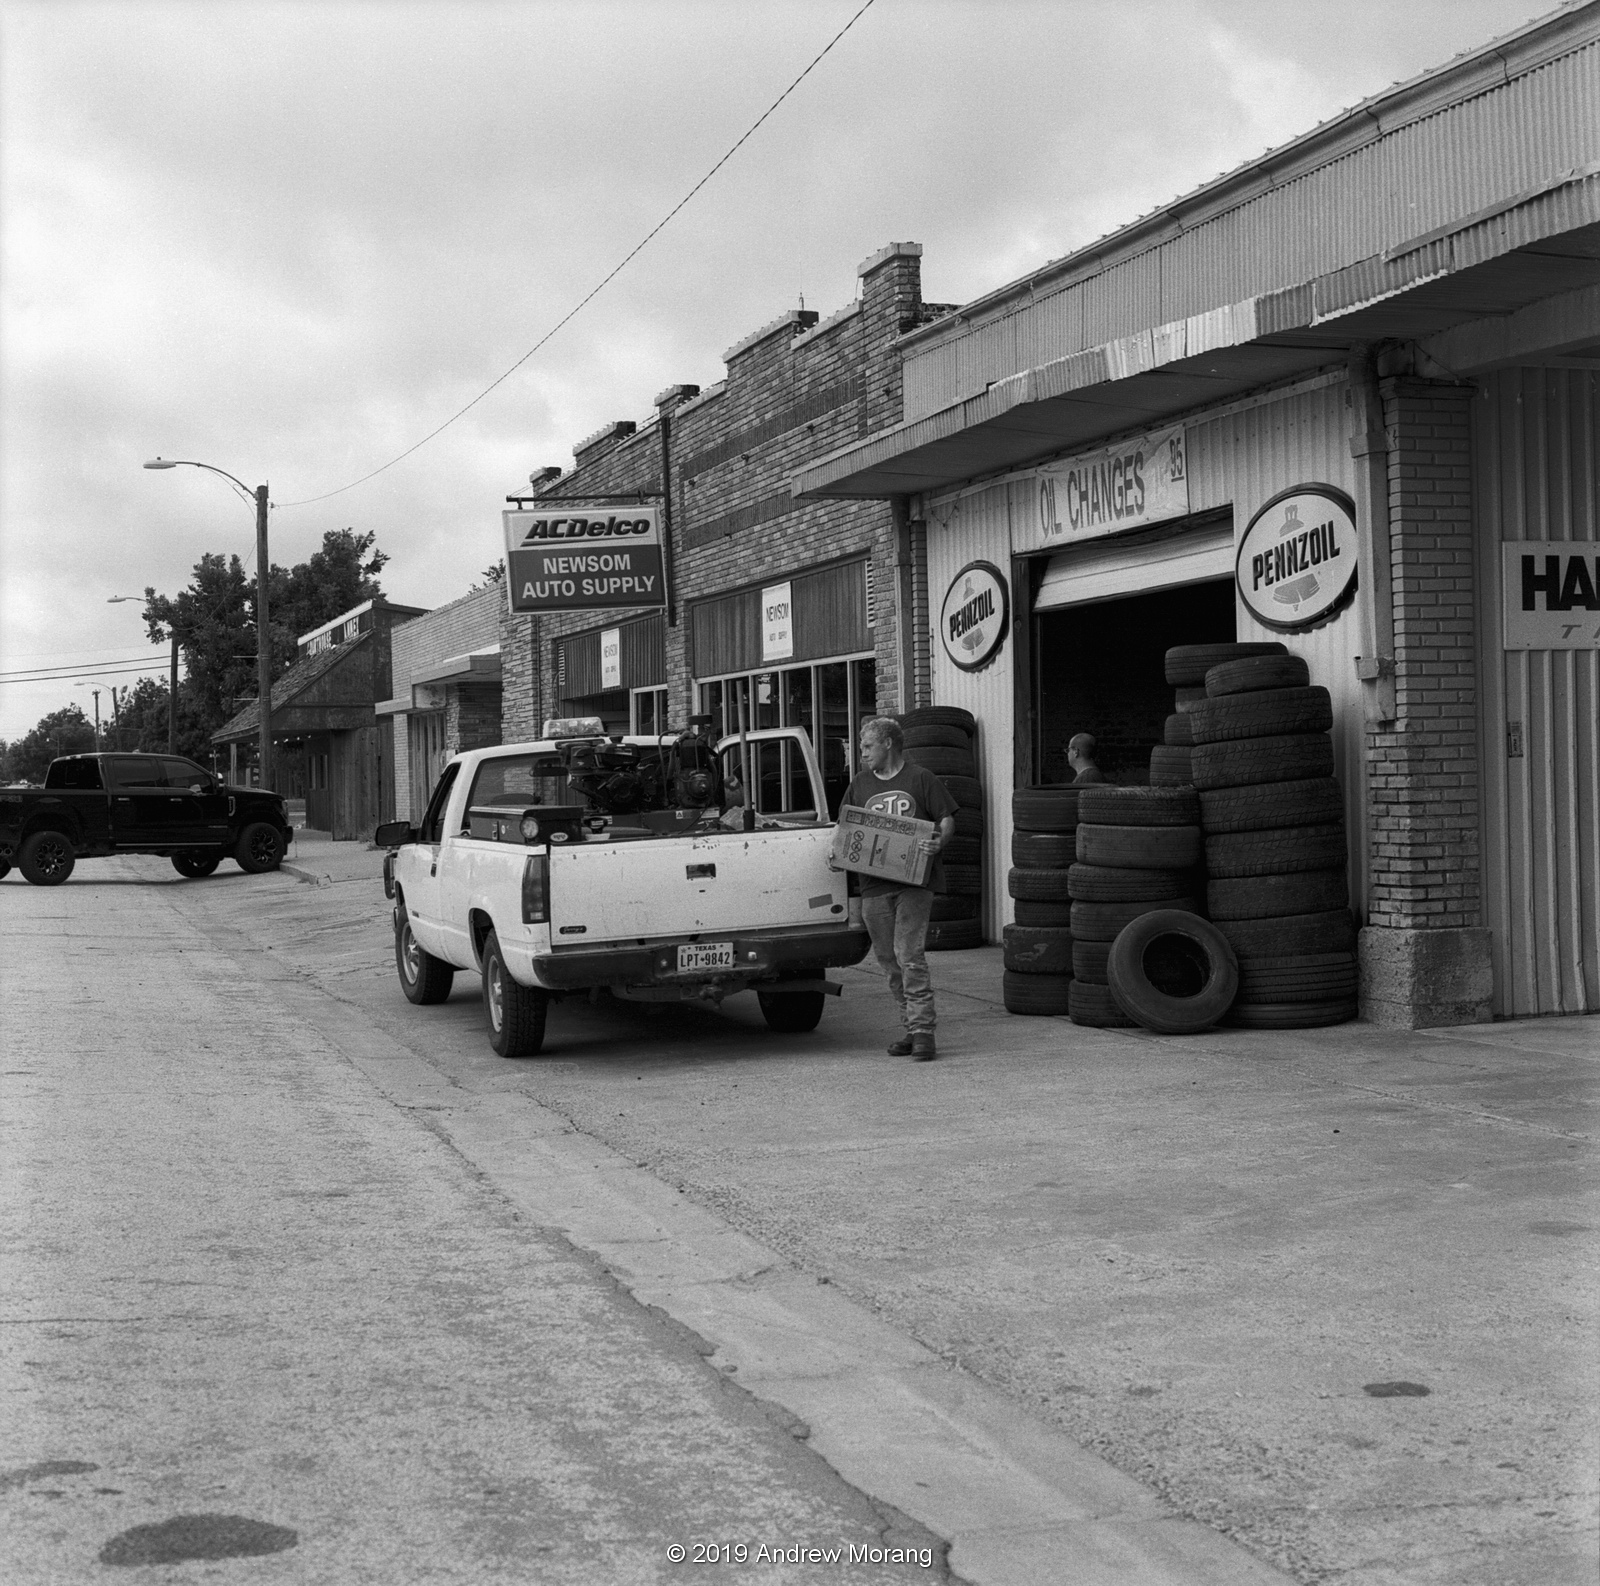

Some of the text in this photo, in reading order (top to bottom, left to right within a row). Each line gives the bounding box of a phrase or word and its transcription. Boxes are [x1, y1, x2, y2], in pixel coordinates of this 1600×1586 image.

[1040, 451, 1145, 540] OIL CHANGES
[525, 516, 650, 539] ACDelco
[543, 554, 631, 574] NEWSOM
[1252, 520, 1341, 592] PENNZOIL
[522, 576, 655, 598] AUTO SUPPLY
[1521, 554, 1600, 611] HA
[766, 602, 789, 622] NEWSOM
[949, 588, 995, 642] PENNZOIL
